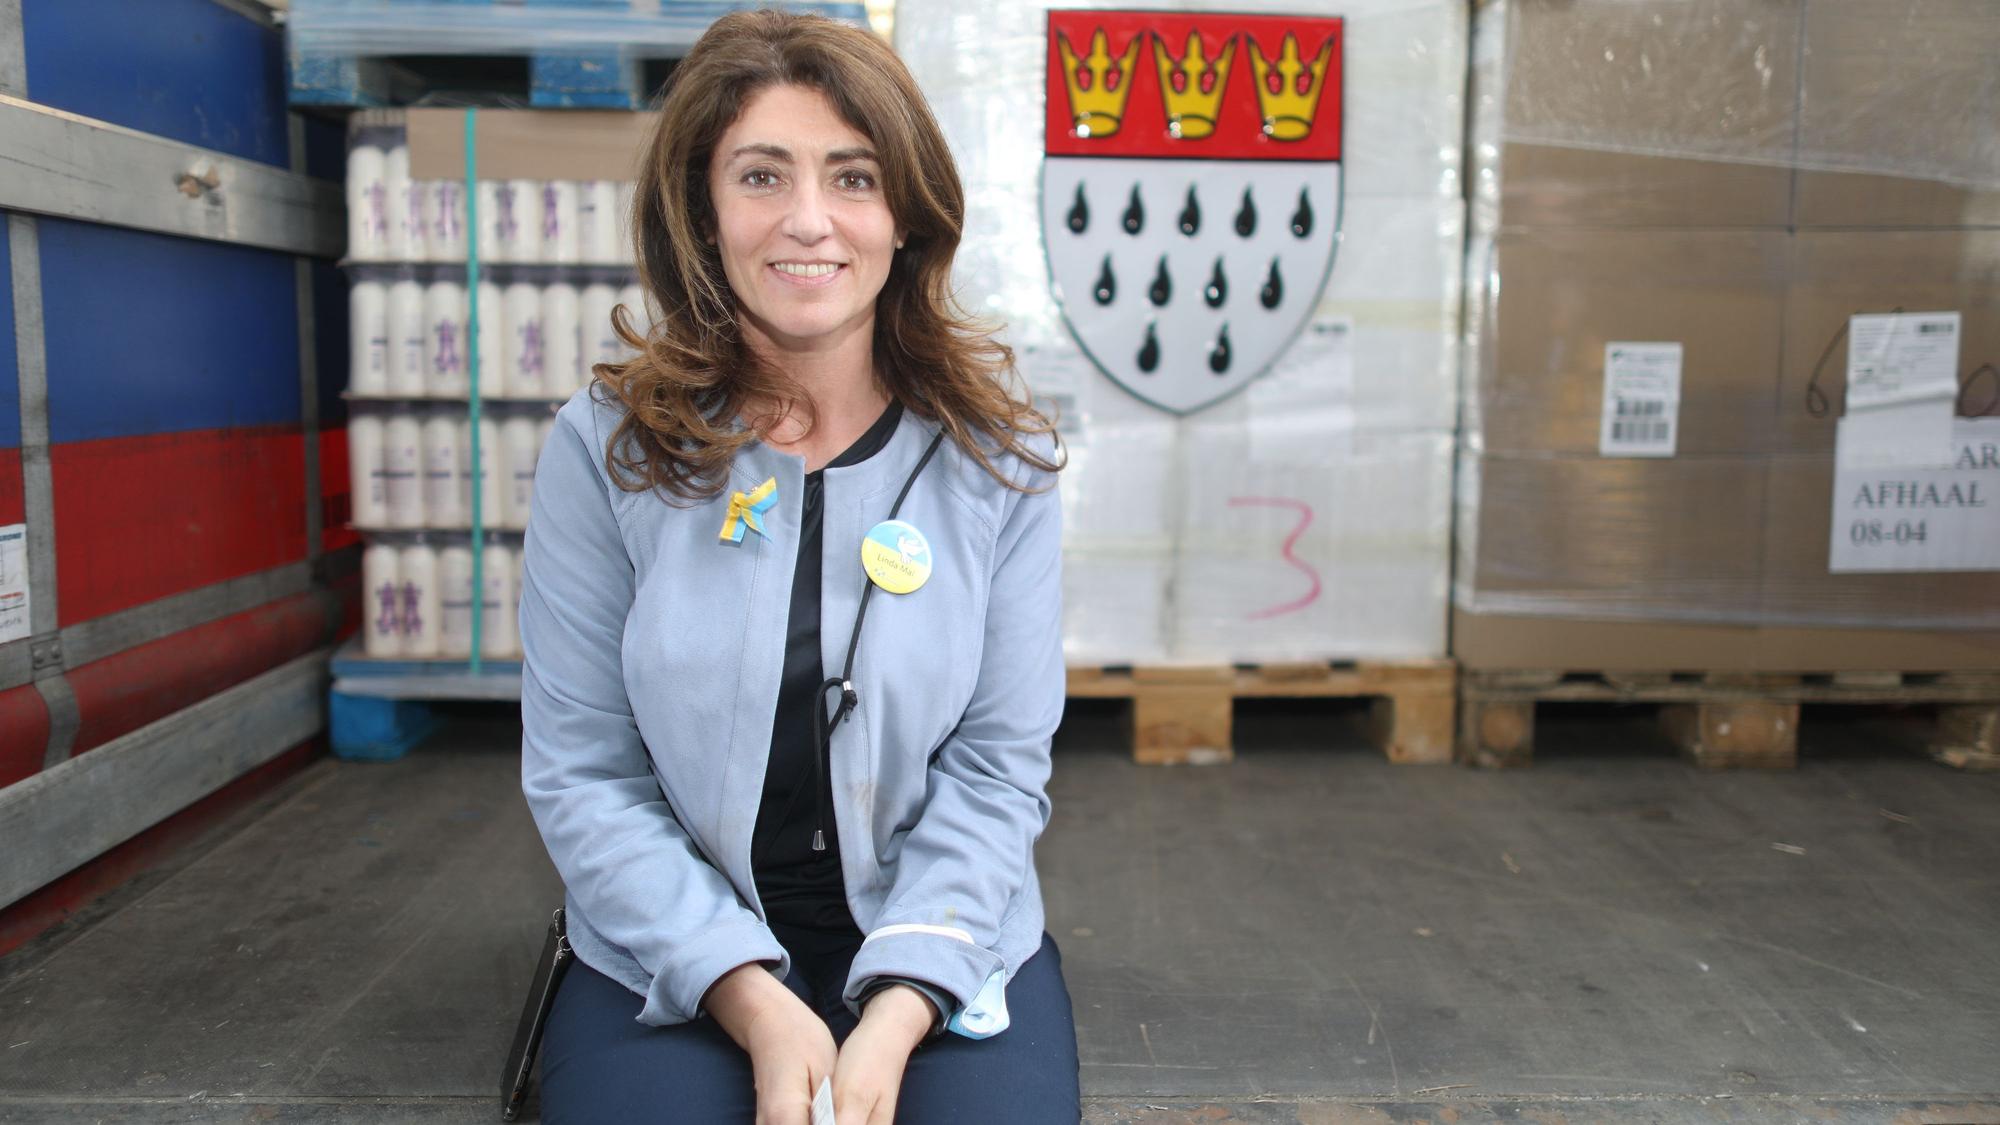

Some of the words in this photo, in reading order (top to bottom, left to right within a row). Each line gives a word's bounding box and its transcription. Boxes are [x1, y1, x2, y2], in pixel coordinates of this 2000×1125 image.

[1952, 442, 2000, 470] AR
[1853, 481, 1986, 508] AFHAAL
[1850, 519, 1927, 544] 08-04
[877, 553, 898, 569] Linda
[1227, 496, 1321, 620] 3
